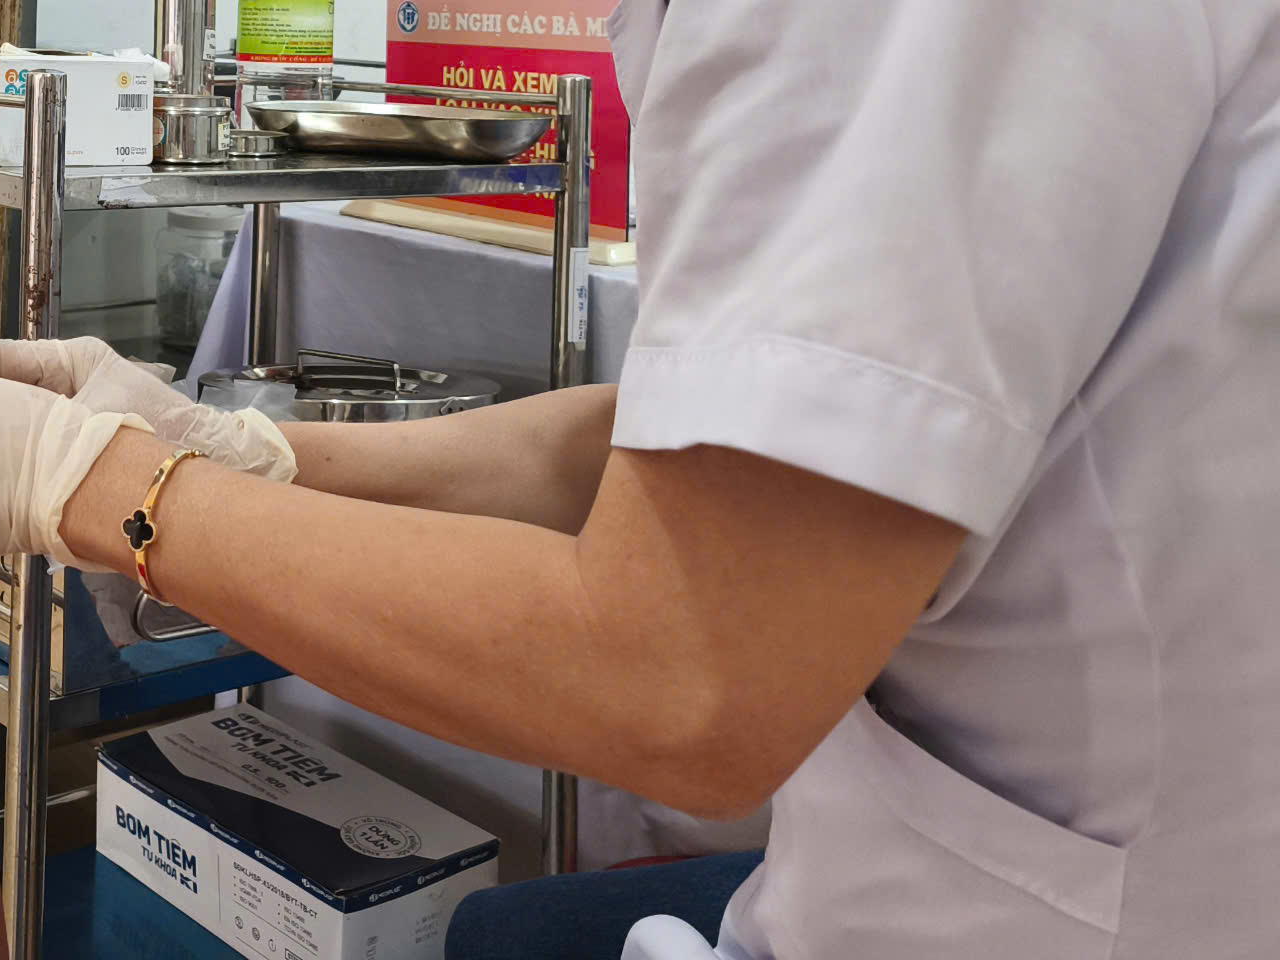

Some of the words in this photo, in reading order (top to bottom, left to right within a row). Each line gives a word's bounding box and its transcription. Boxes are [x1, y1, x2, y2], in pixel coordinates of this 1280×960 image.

[455, 12, 502, 36] NGHỊ
[506, 11, 546, 34] CÁC
[552, 11, 581, 36] BÀ
[442, 60, 474, 88] HỎI
[480, 65, 506, 90] VÀ
[512, 70, 558, 94] XEM
[115, 146, 130, 156] 100
[153, 830, 197, 878] TIÊM
[180, 873, 198, 894] KI
